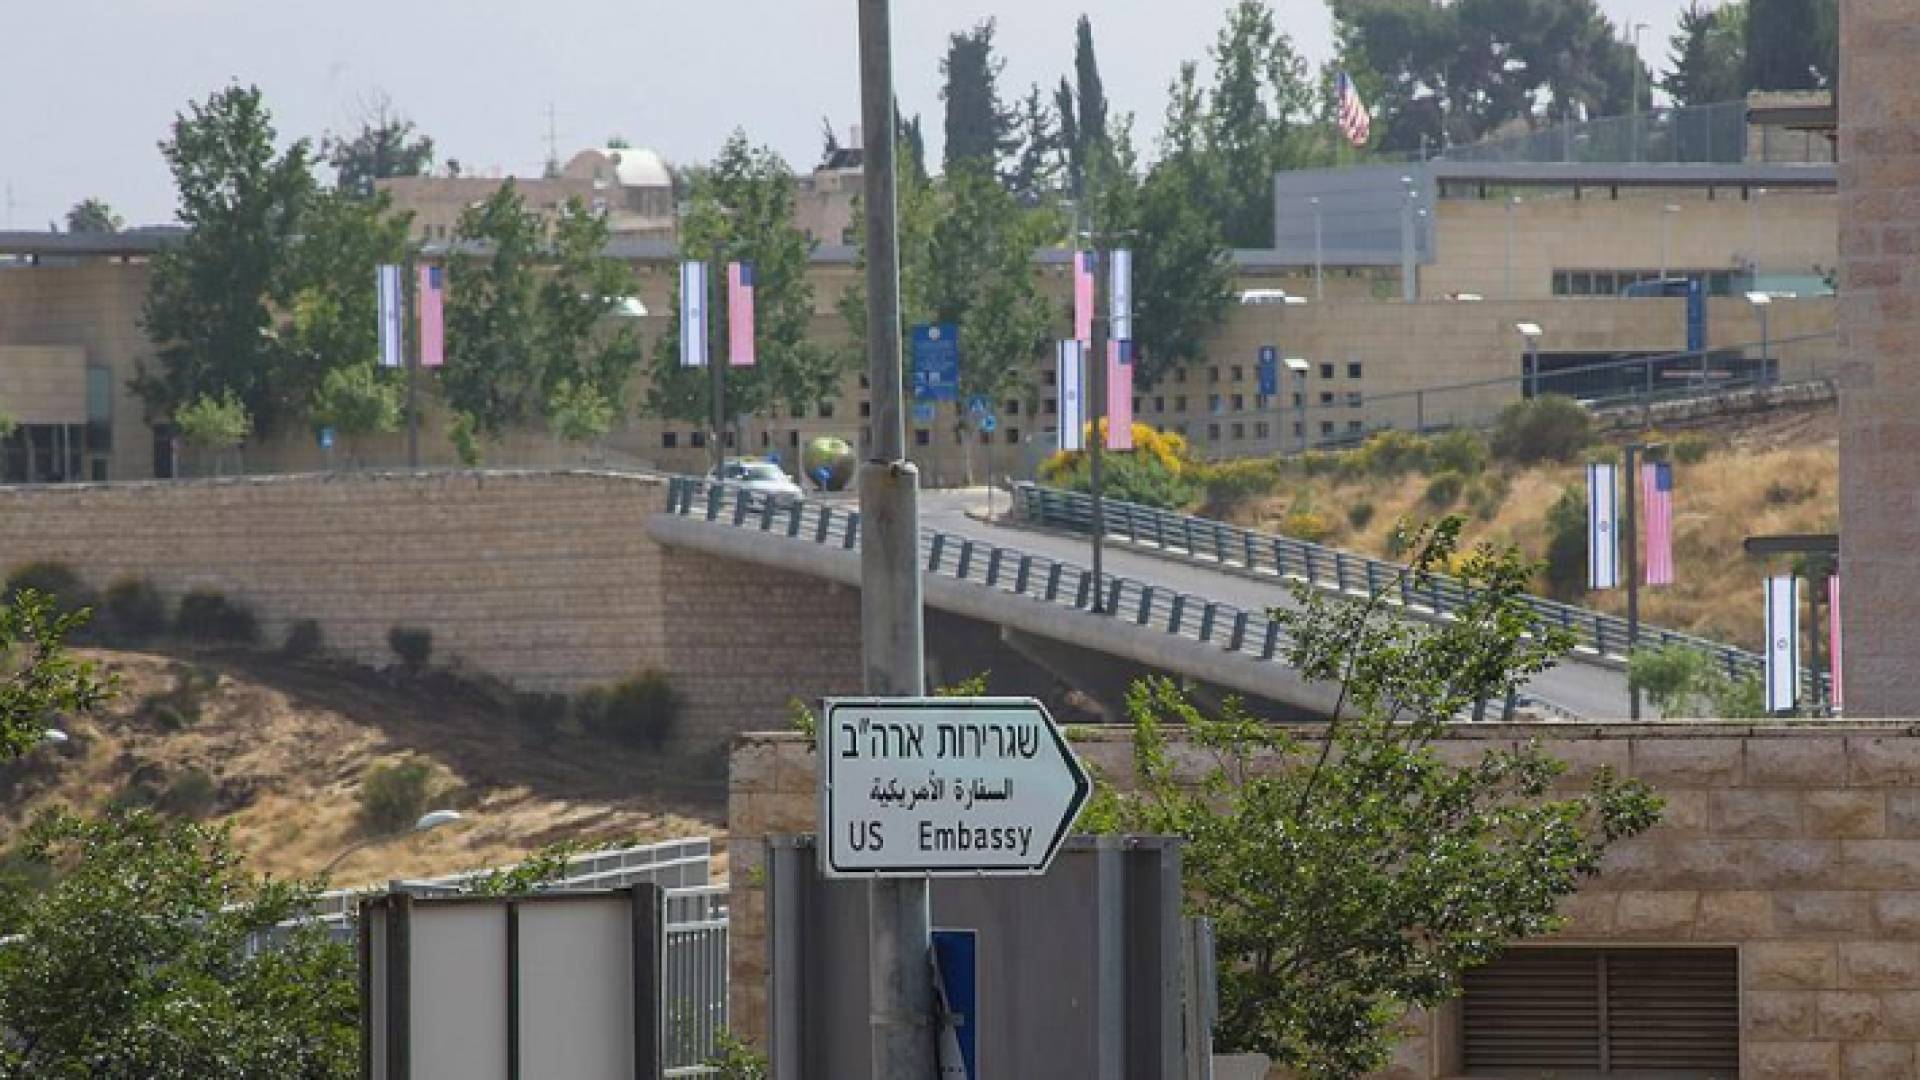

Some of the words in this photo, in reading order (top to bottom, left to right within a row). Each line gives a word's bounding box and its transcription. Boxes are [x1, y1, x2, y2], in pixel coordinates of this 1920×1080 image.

[937, 723, 1039, 759] שגרירות
[869, 769, 945, 810] الأمريكية
[954, 776, 1014, 810] السفارة
[849, 820, 884, 852] US
[918, 820, 1033, 857] Embassy
